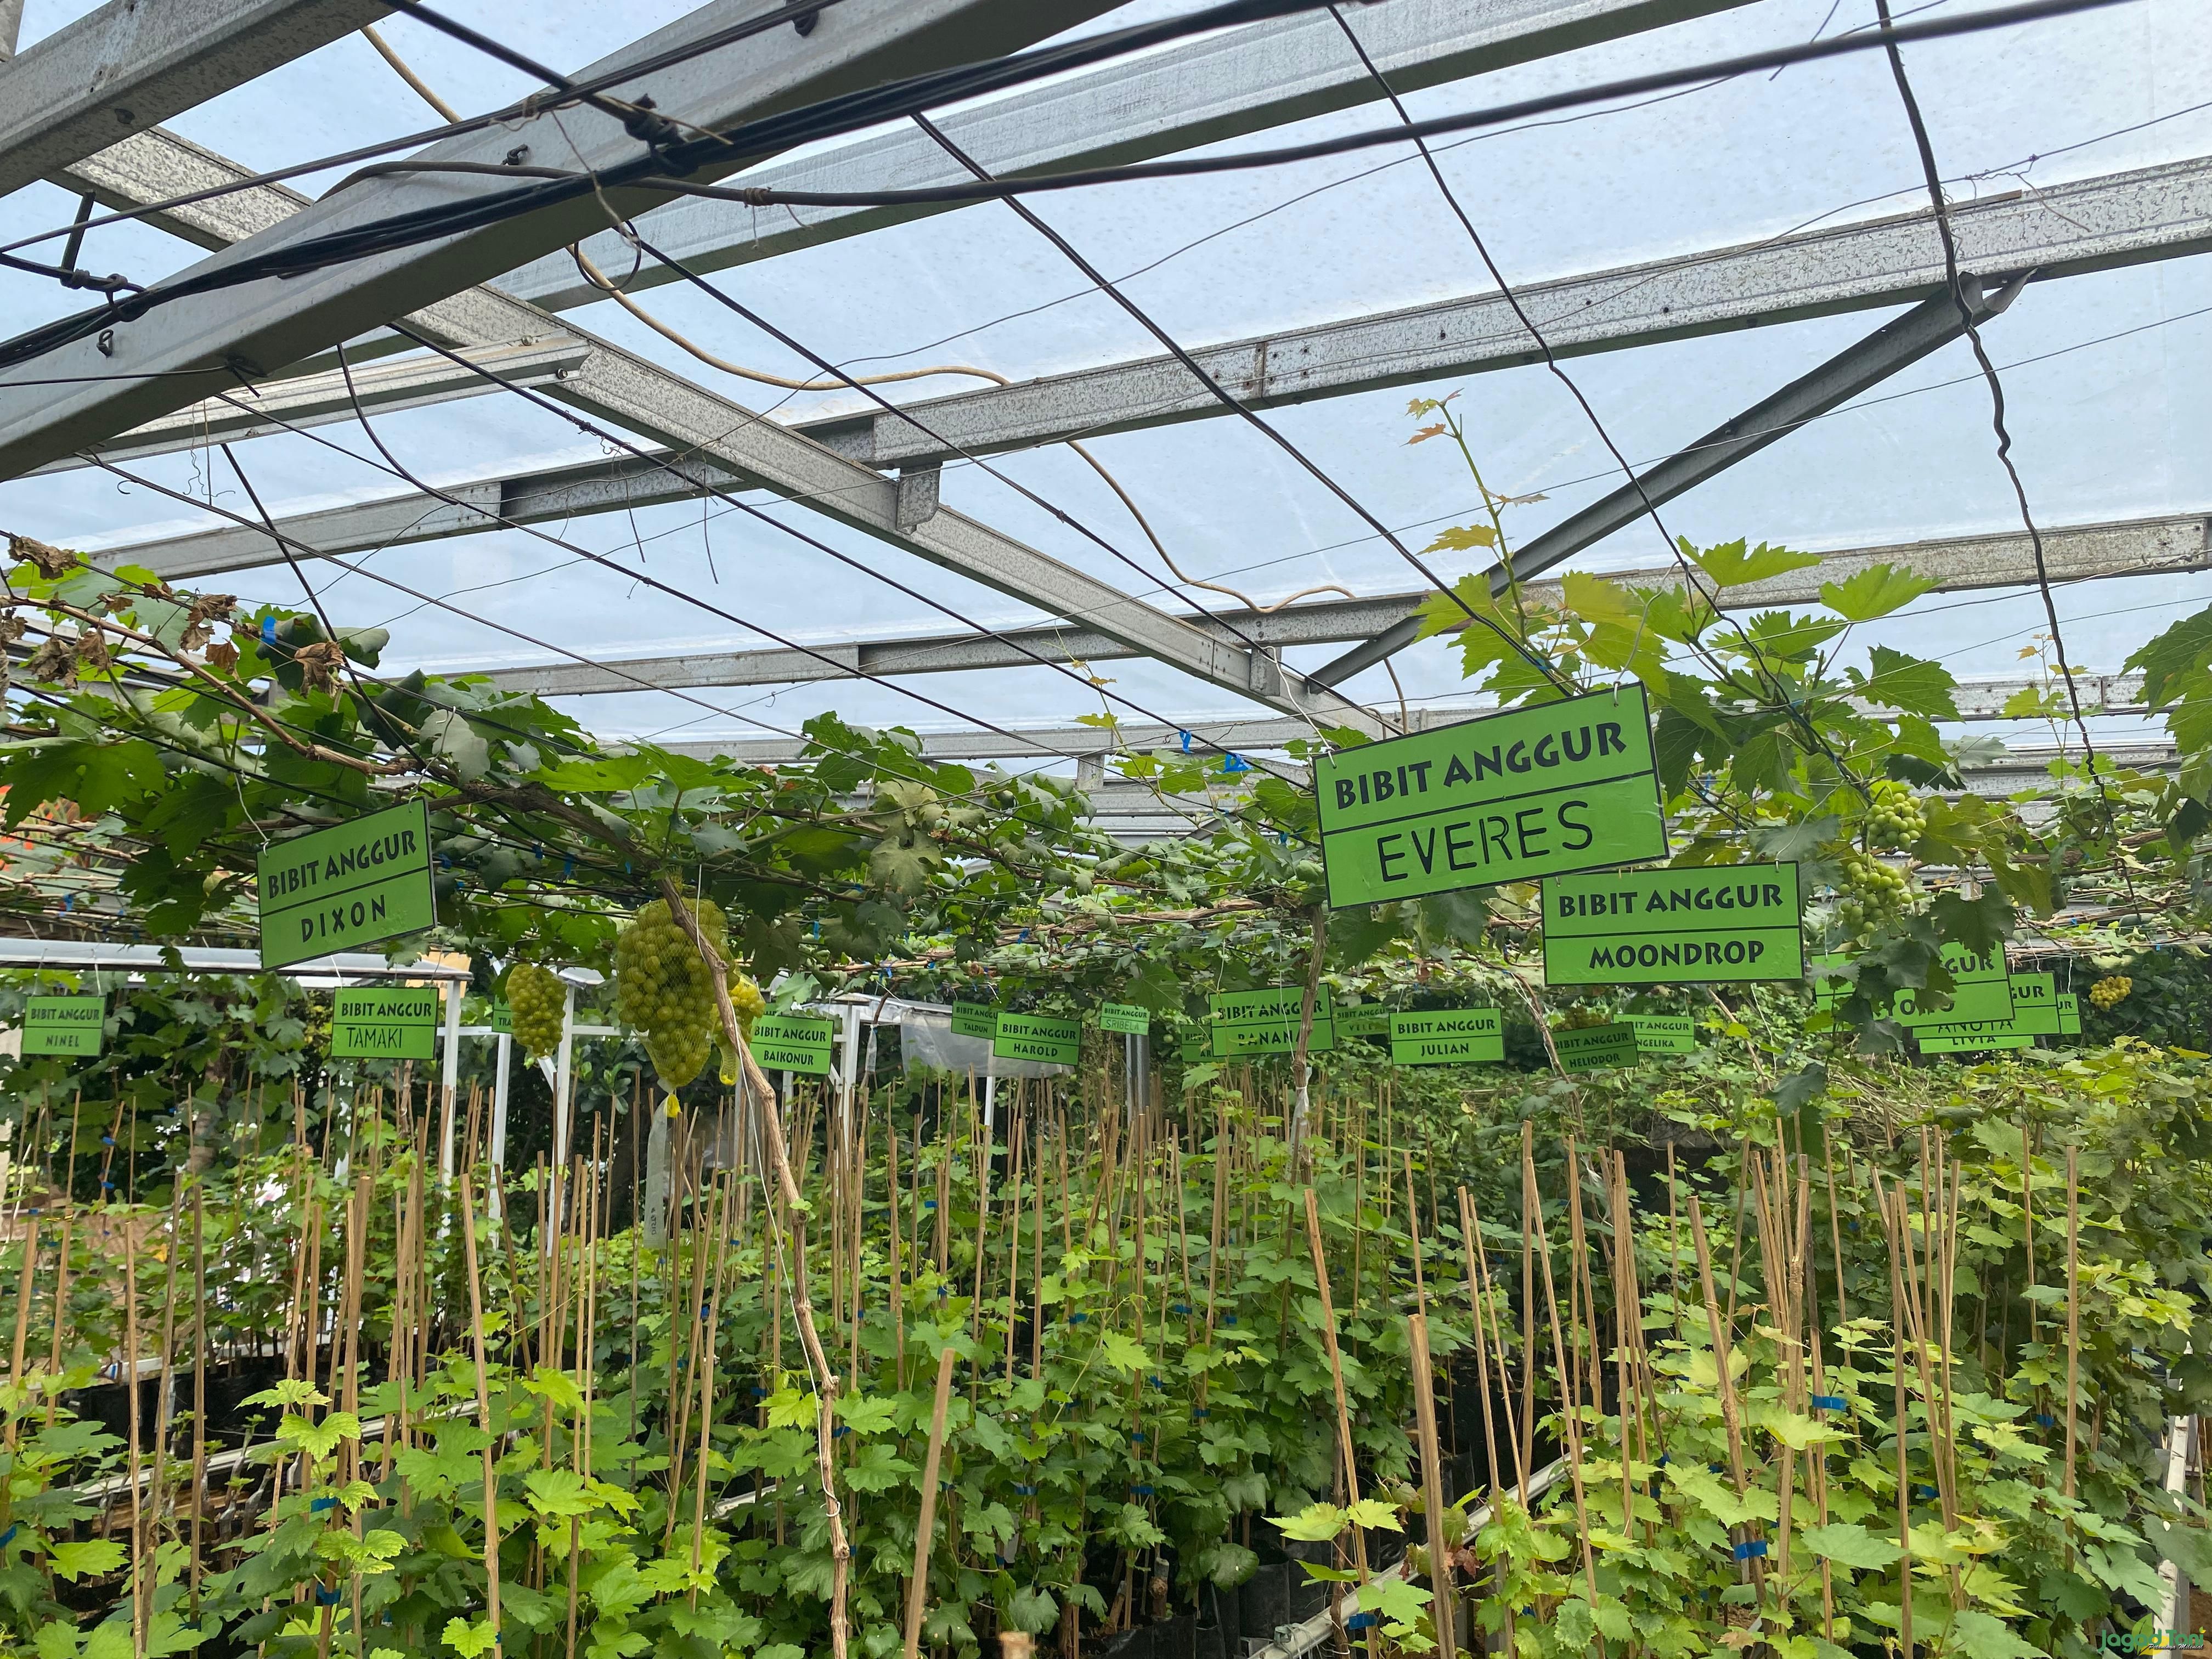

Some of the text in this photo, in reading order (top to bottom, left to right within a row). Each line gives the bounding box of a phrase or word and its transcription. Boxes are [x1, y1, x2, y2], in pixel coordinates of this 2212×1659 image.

[1335, 722, 1627, 810] BIBIT ANGGUR
[1377, 800, 1593, 882] EVERES
[268, 830, 417, 900] BIBIT ANGGUR
[1559, 884, 1784, 917] BIBIT ANGGUR
[301, 894, 386, 943] DIXON
[1589, 940, 1764, 969] MOONDROP
[31, 1008, 100, 1020] BIBIT ANGGUR
[342, 1002, 432, 1017] BIBIT ANGGUR
[956, 1006, 997, 1019] BIBIT ANGGU
[1121, 1009, 1147, 1018] ANGGUR
[1218, 1000, 1323, 1020] BIBIT ANGGR
[1337, 1007, 1385, 1019] BIBIT ANGGU
[964, 1023, 988, 1033] TALDUN
[1002, 1023, 1076, 1040] BIBIT ANGGUR
[1105, 1019, 1139, 1031] SRIBELA
[1397, 1019, 1496, 1034] BIBIT ANGGUR
[1646, 1022, 1690, 1030] ANGGUR
[46, 1035, 79, 1047] NINEL
[346, 1027, 402, 1048] TAMAKI
[754, 1025, 826, 1042] BIBIT ANGGUR
[1554, 1032, 1629, 1049] BIBIT ANGGUR
[1013, 1043, 1058, 1057] HAROLD
[1420, 1043, 1469, 1057] JULIAN
[1636, 1039, 1675, 1047] NGELIKA
[764, 1050, 814, 1065] BAIKONUR
[1569, 1052, 1620, 1068] HELIODOR
